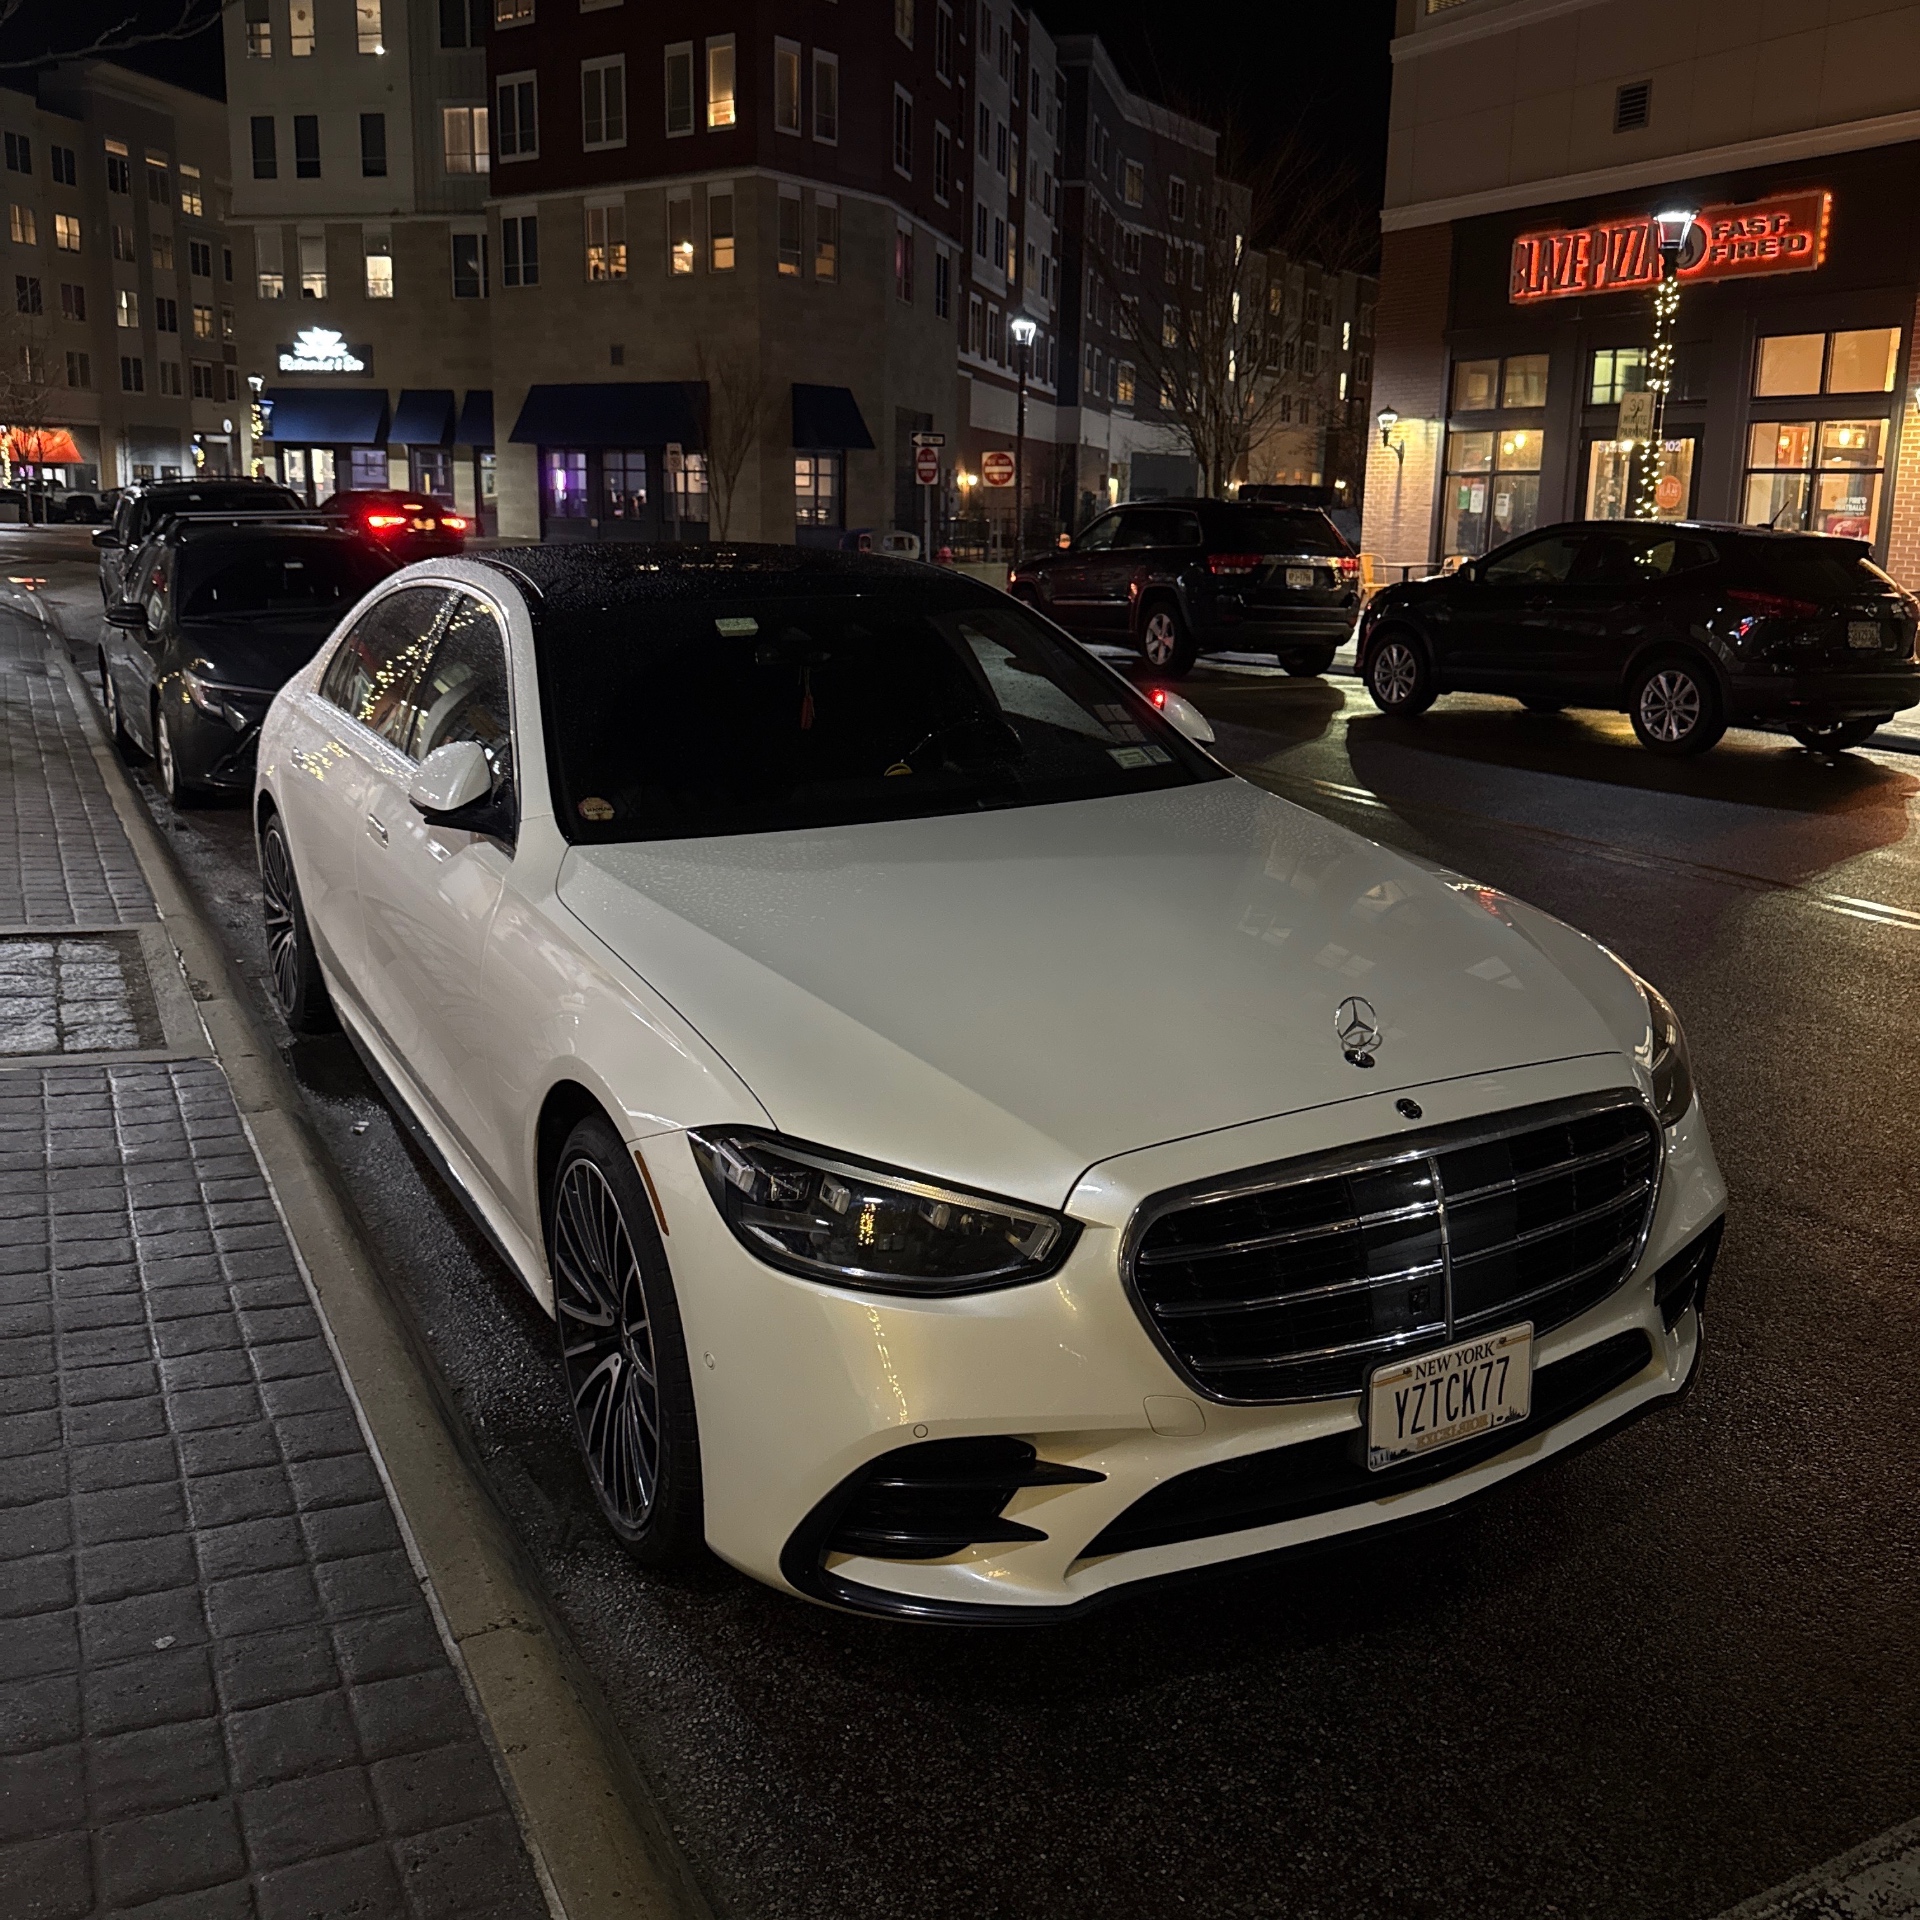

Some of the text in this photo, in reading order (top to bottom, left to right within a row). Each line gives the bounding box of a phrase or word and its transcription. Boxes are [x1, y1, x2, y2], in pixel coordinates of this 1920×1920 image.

[1510, 223, 1661, 293] BLAZE PIZZA
[1708, 234, 1807, 262] FIRE'D
[1628, 398, 1644, 412] 30
[1623, 415, 1647, 425] MINUTE
[1665, 441, 1681, 452] 102
[1414, 1341, 1495, 1380] NEW YORK
[1394, 1355, 1510, 1439] YZTCK77
